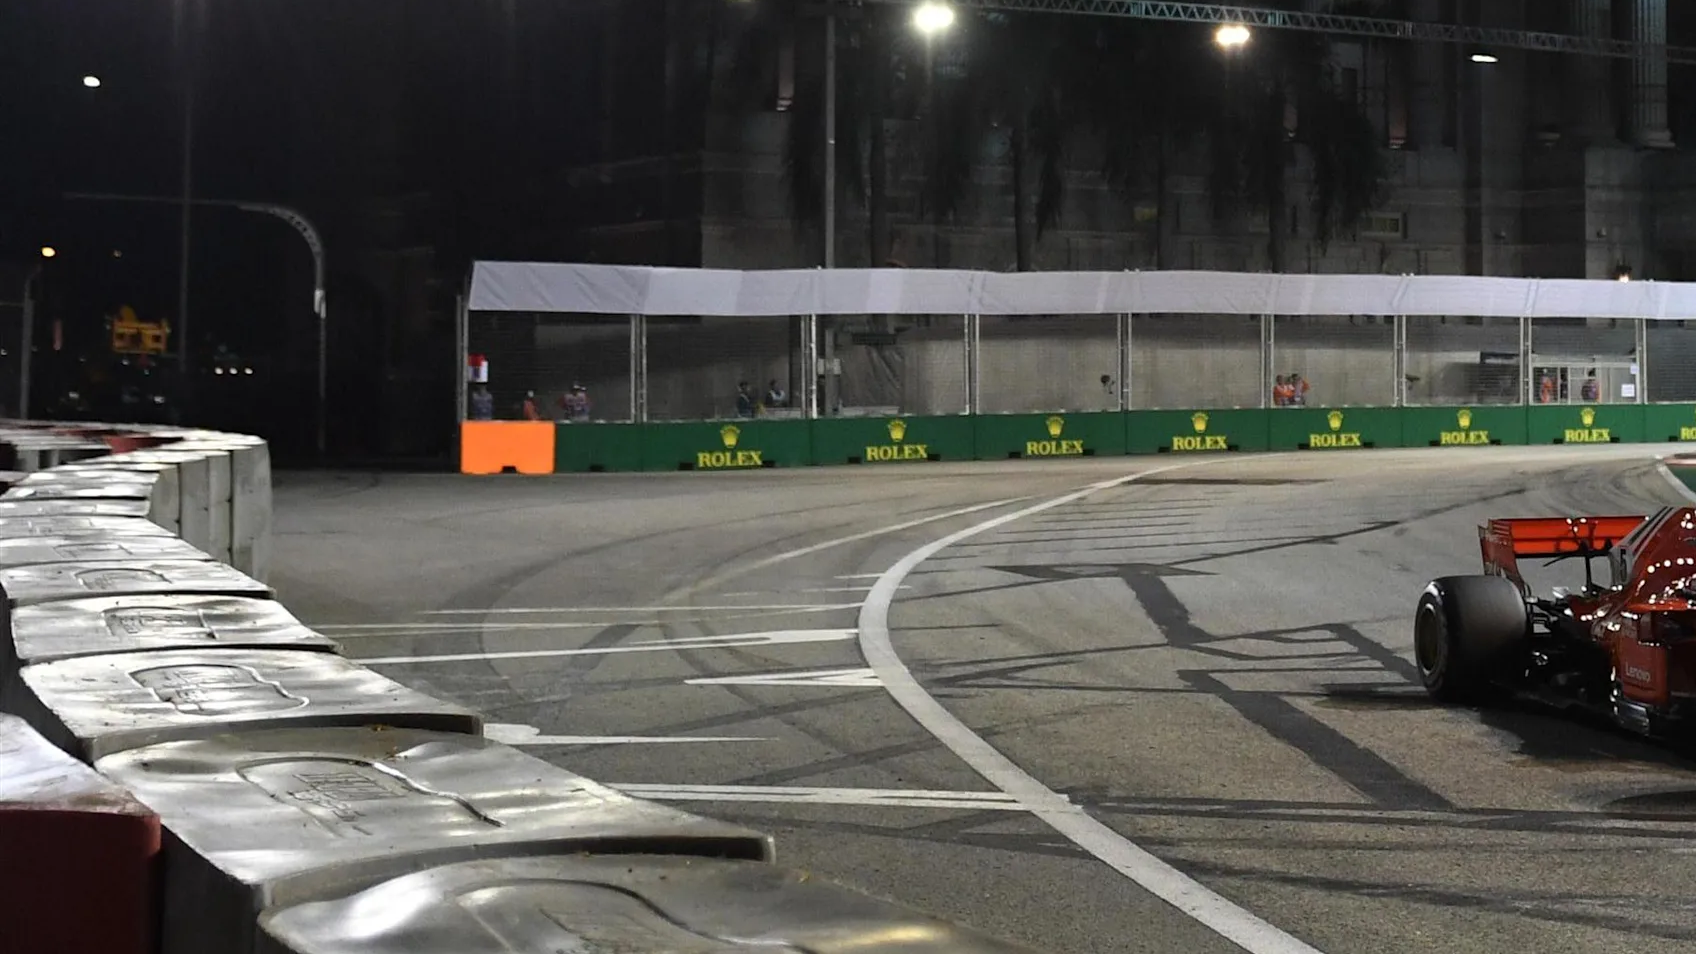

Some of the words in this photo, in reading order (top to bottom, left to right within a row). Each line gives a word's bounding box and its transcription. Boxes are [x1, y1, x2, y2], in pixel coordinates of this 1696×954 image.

[1309, 433, 1361, 447] ROLEX
[1440, 431, 1489, 445] ROLEX
[1564, 429, 1611, 443] ROLEX
[1026, 441, 1084, 455] ROLEX
[1172, 436, 1228, 451] ROLEX
[697, 451, 763, 468] ROLEX
[866, 445, 928, 461] ROLEX
